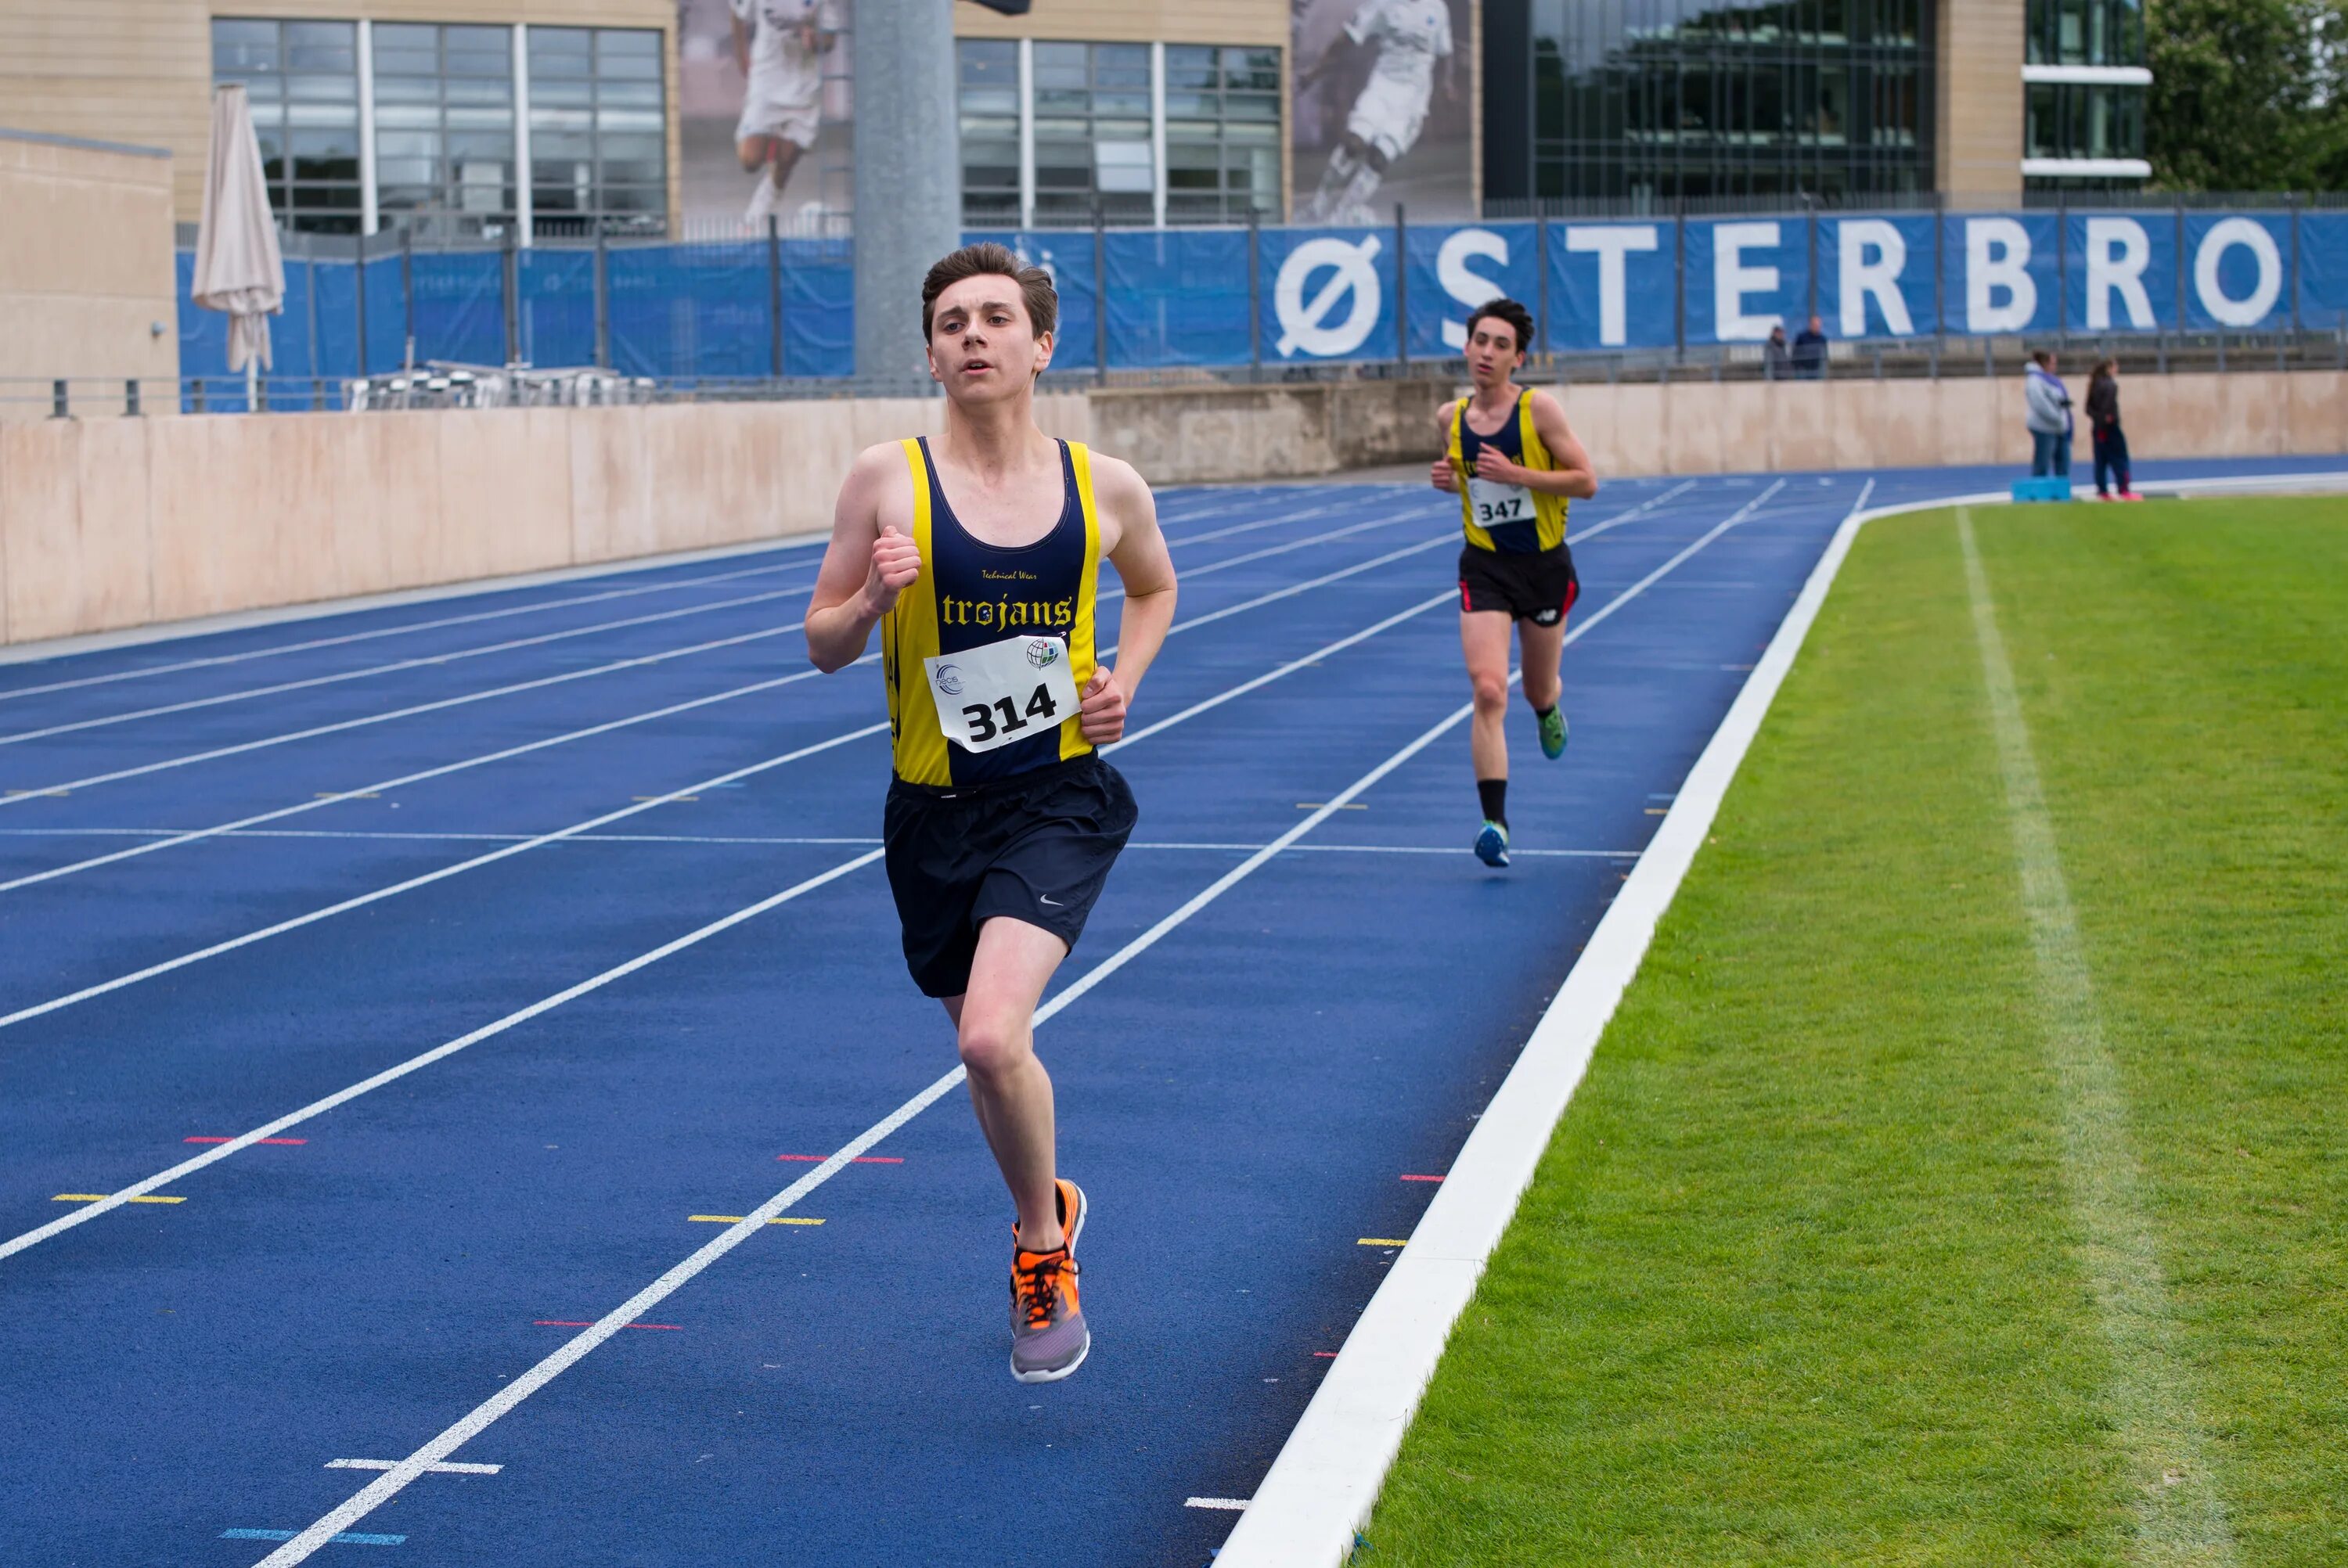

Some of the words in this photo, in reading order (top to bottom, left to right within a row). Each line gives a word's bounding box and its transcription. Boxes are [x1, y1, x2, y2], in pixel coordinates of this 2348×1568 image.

[1479, 498, 1521, 521] 347
[981, 569, 1017, 580] Technical
[1019, 570, 1037, 580] Wear
[942, 593, 1072, 632] trojans
[962, 682, 1057, 743] 314
